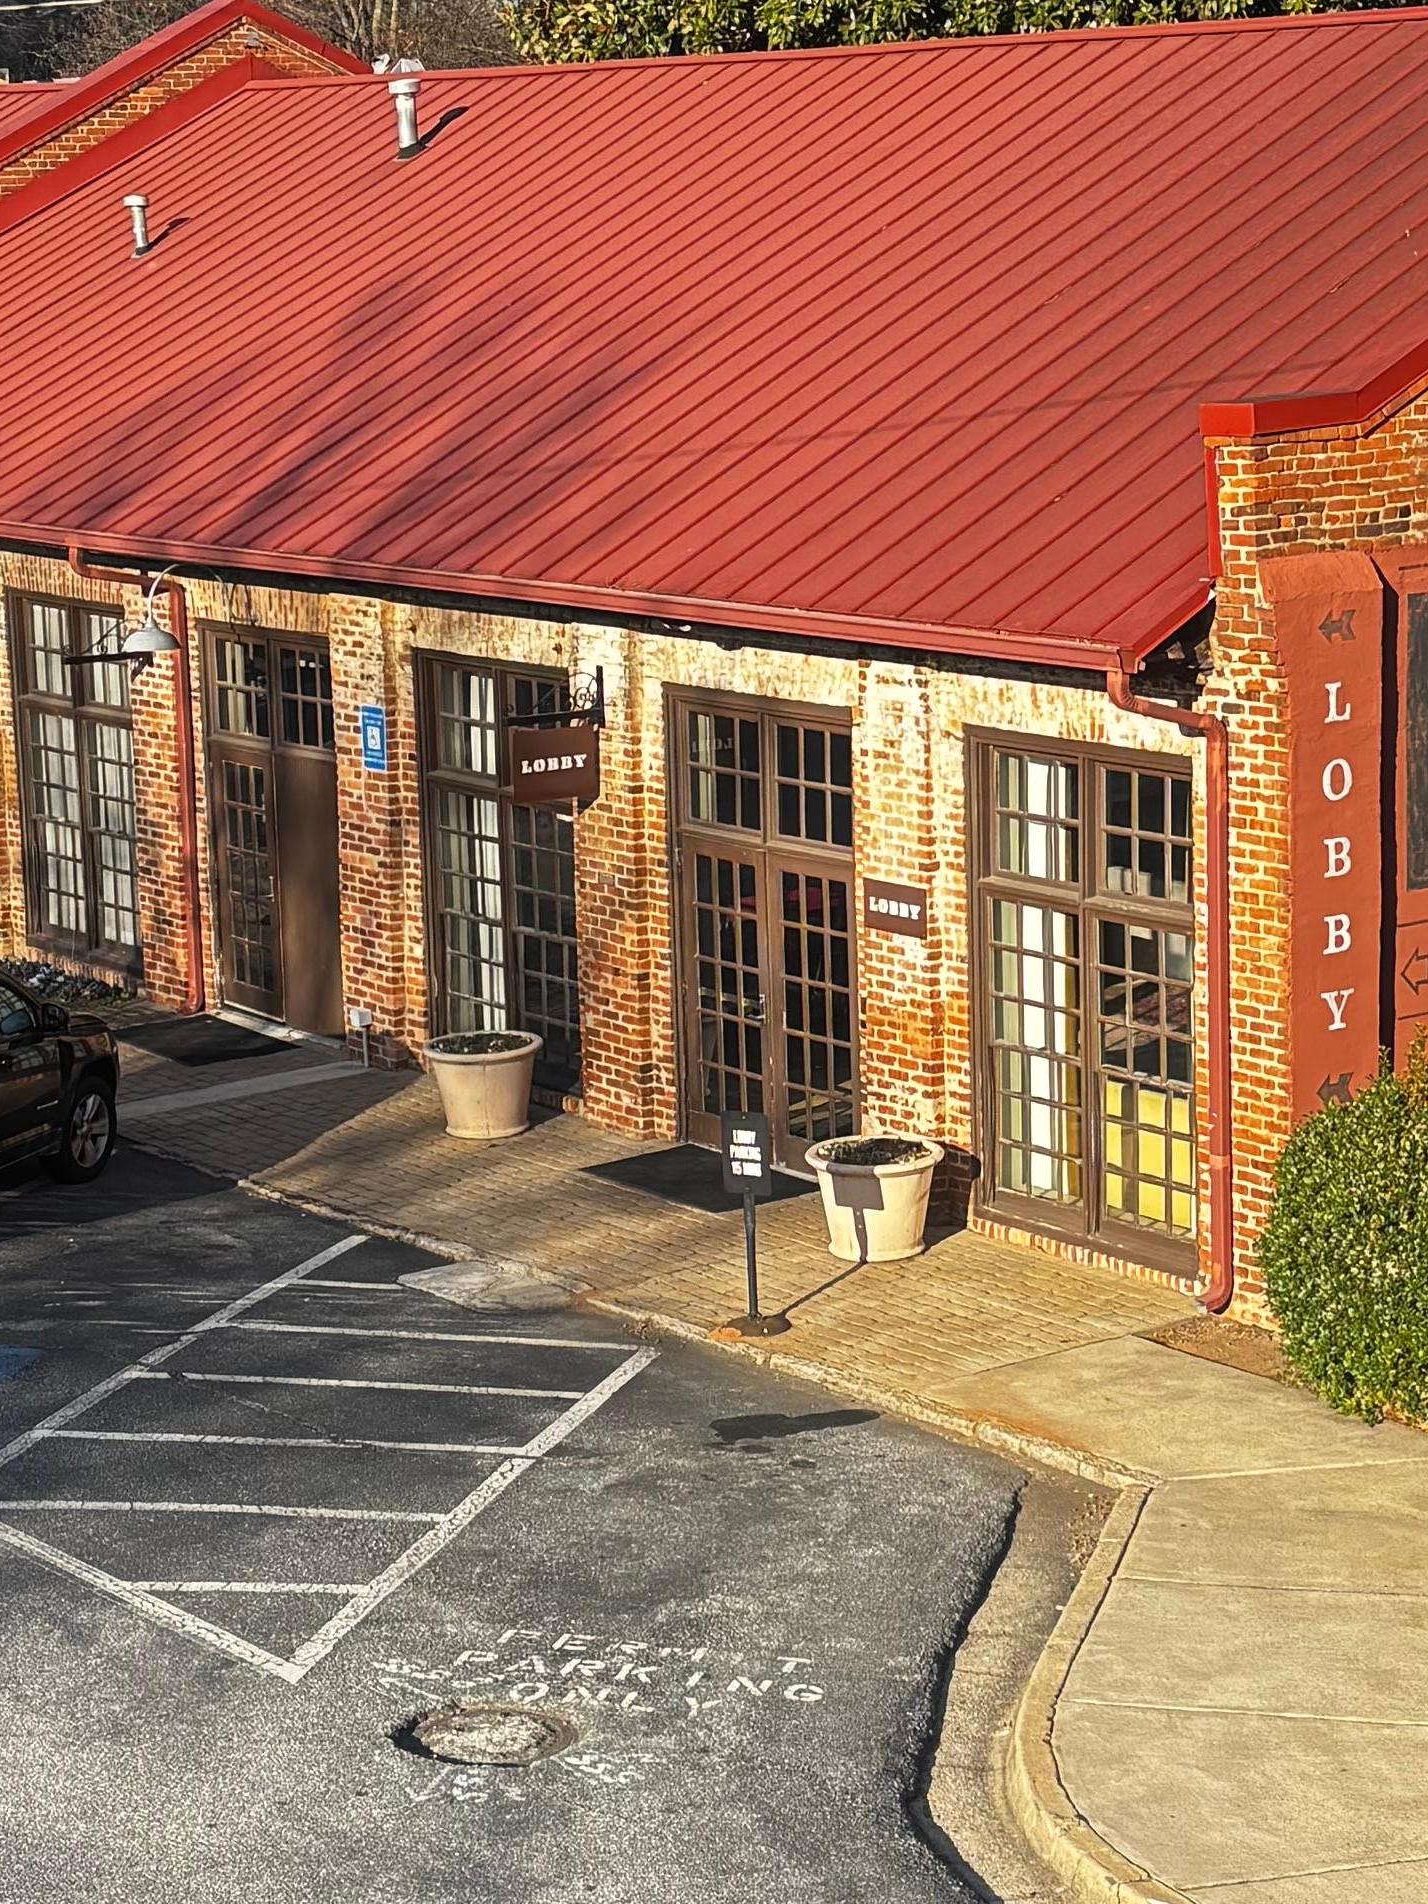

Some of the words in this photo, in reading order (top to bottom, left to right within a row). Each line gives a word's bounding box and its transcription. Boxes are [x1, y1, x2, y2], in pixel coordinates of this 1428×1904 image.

[521, 753, 587, 774] LOBBY
[1321, 680, 1355, 1031] LOBBY
[868, 896, 921, 920] LOBBY
